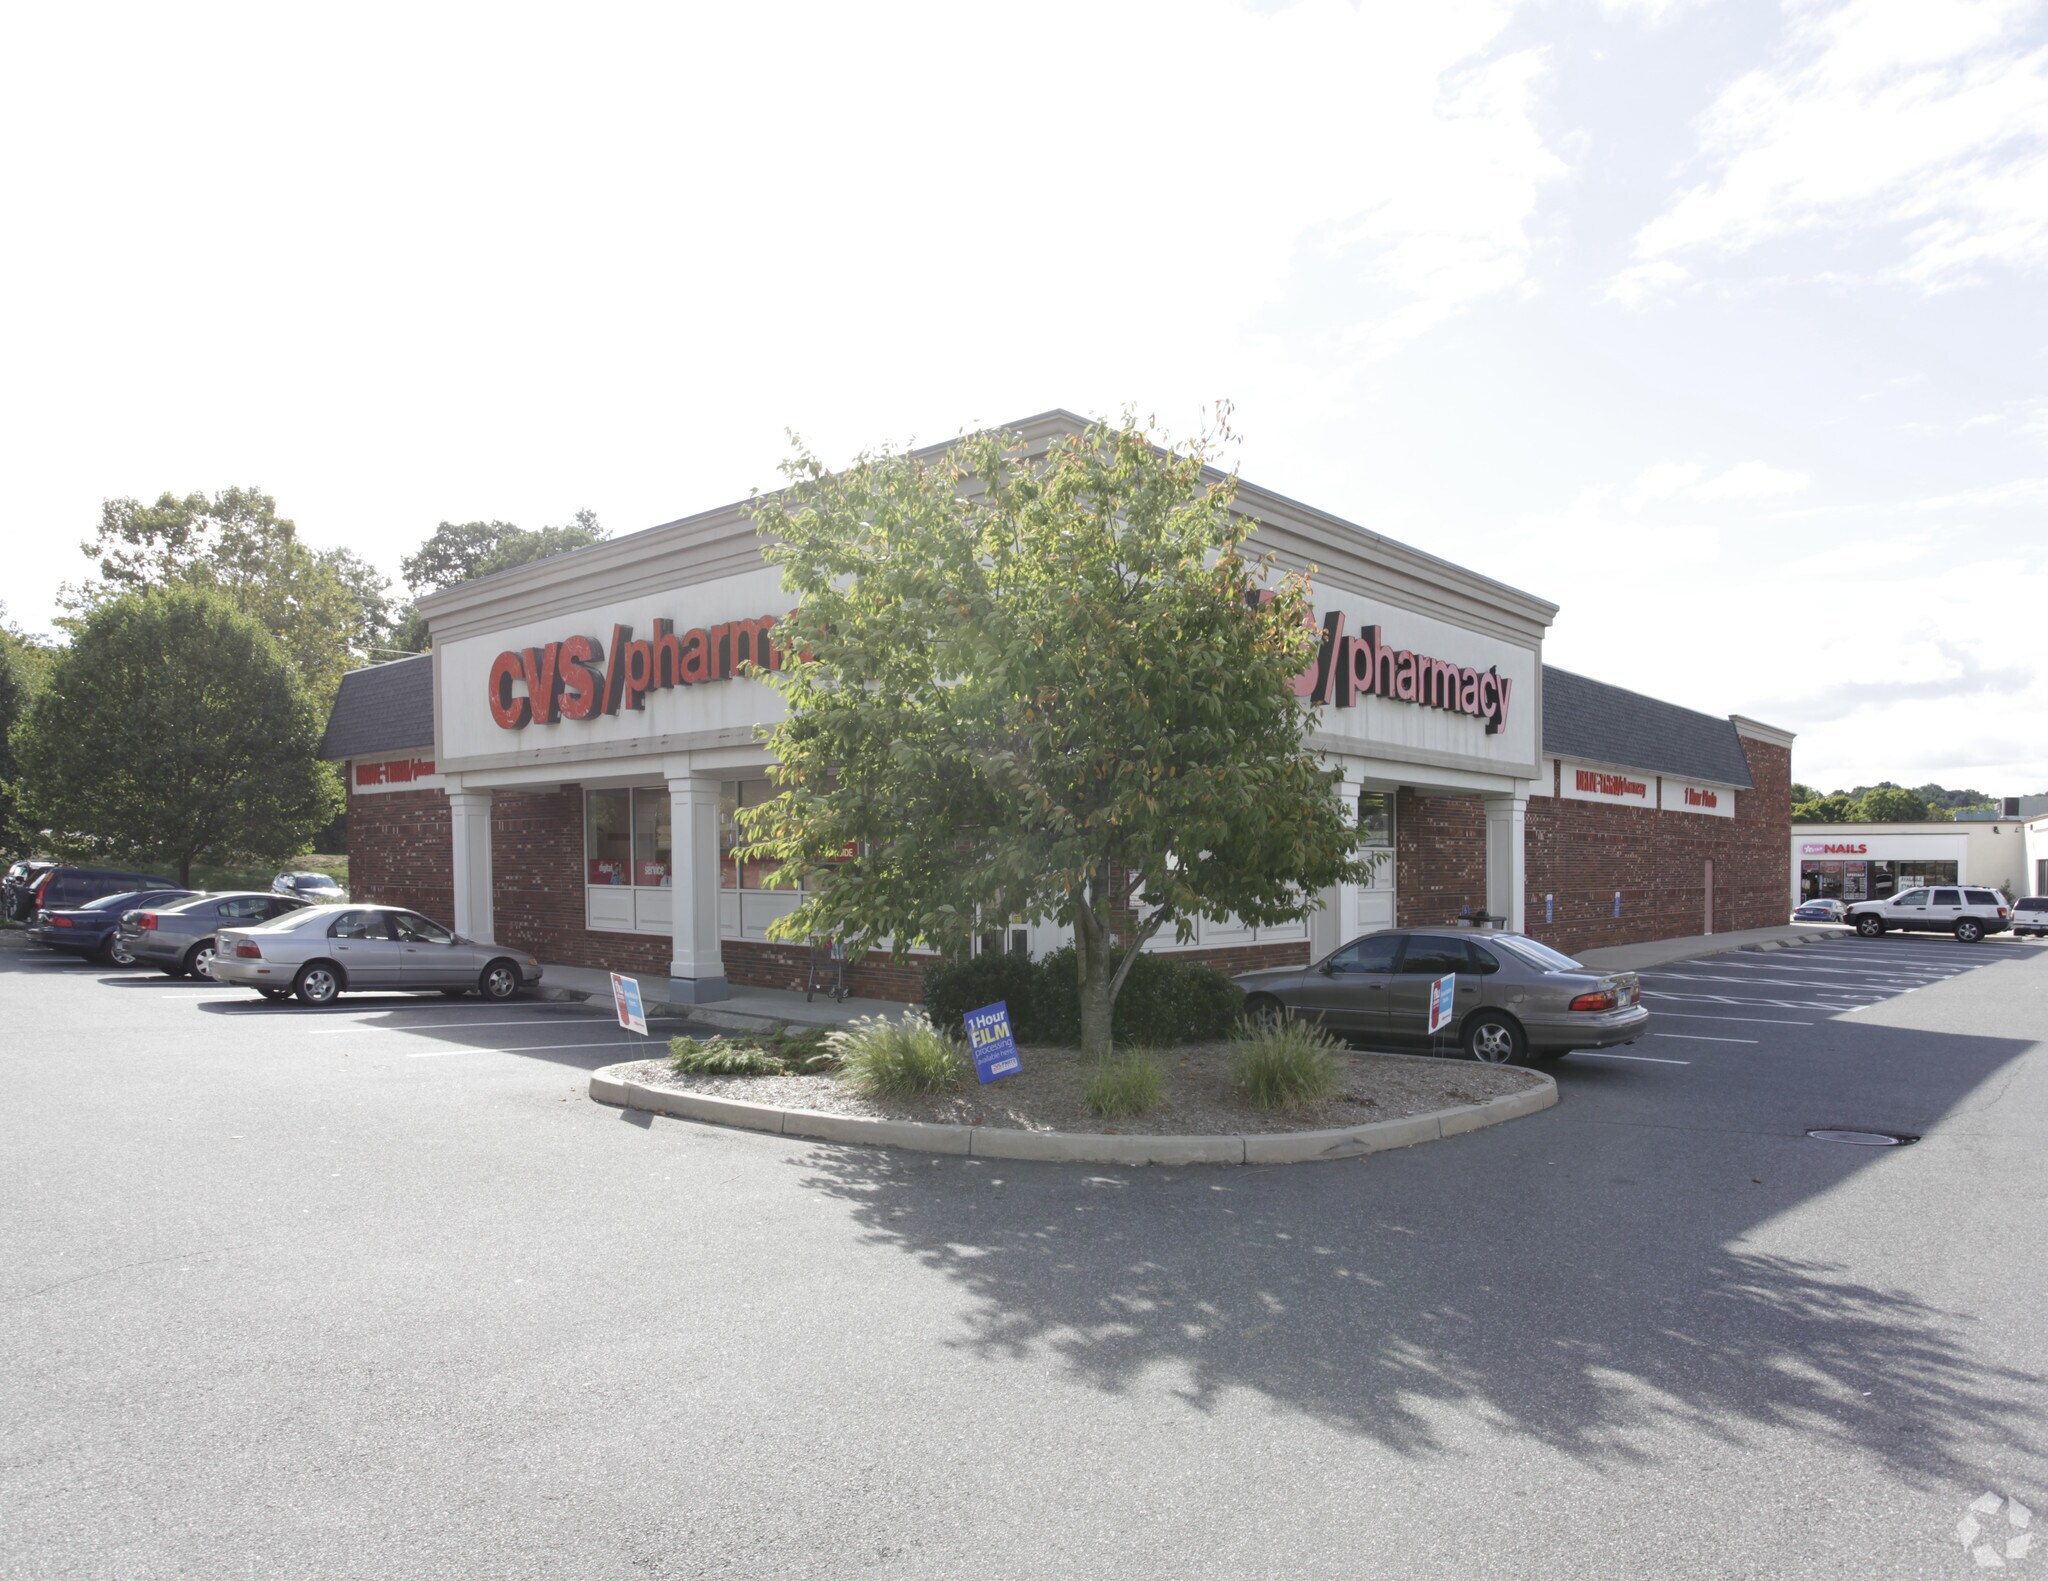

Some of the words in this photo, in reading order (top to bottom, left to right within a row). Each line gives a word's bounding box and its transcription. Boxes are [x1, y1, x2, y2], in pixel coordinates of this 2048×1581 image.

[488, 606, 830, 730] CVS/pharm
[1245, 588, 1512, 735] /pharmacy
[1824, 844, 1867, 854] NAILS
[644, 863, 664, 875] service
[968, 1018, 975, 1030] 1
[976, 1011, 1005, 1028] Hour
[971, 1022, 1010, 1049] FILM
[975, 1038, 1012, 1059] processing
